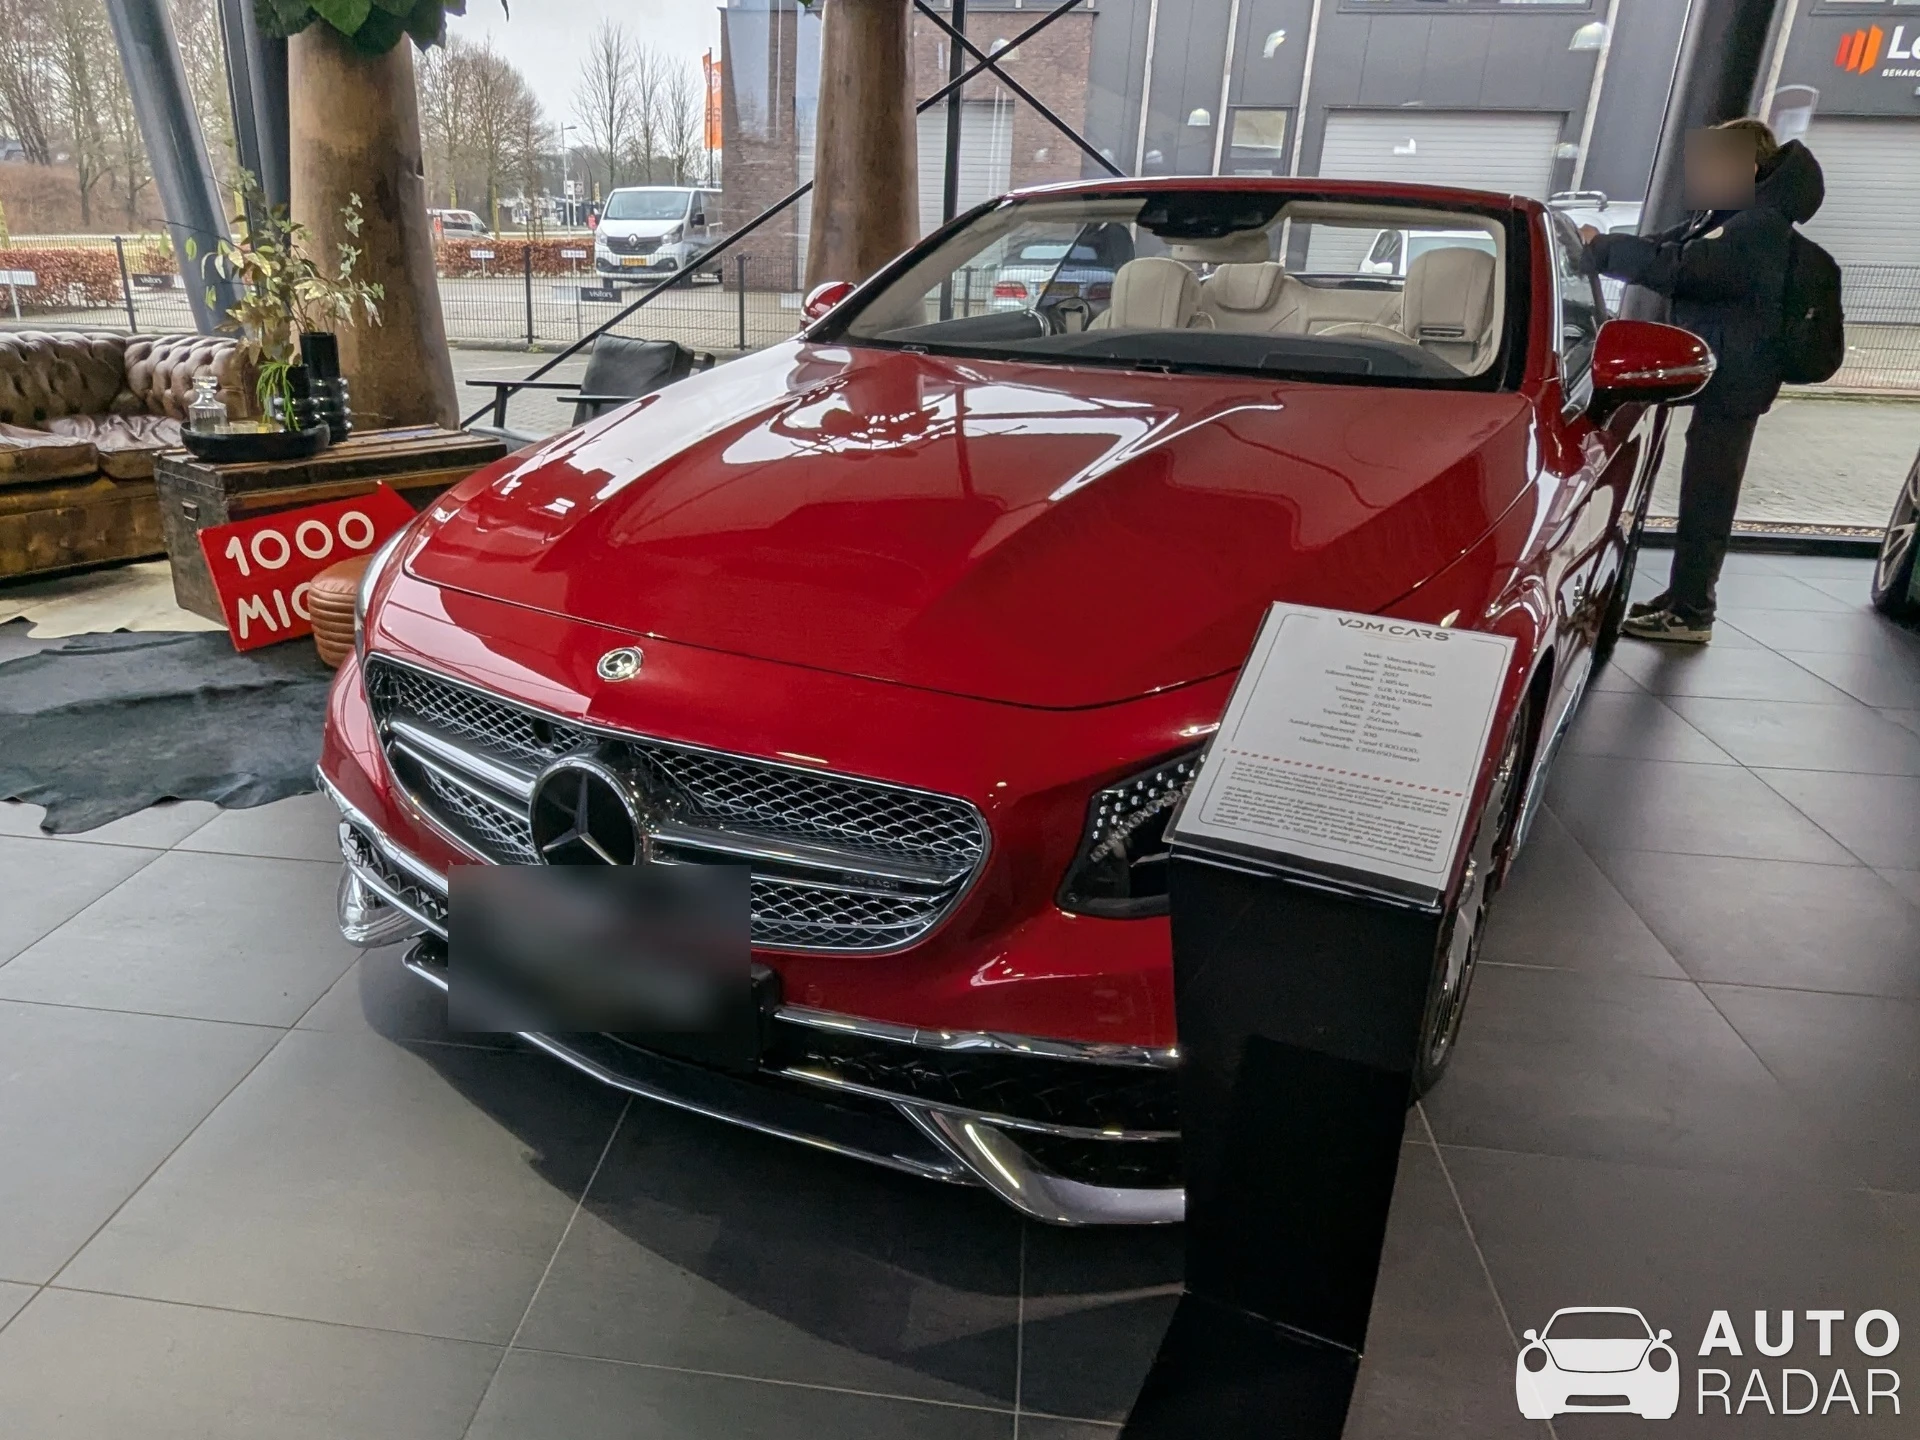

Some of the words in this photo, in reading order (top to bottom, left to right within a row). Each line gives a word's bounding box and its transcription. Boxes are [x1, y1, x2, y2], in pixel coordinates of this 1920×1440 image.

[225, 511, 374, 577] 1000
[1338, 617, 1384, 632] VDM
[1388, 625, 1450, 641] CARS
